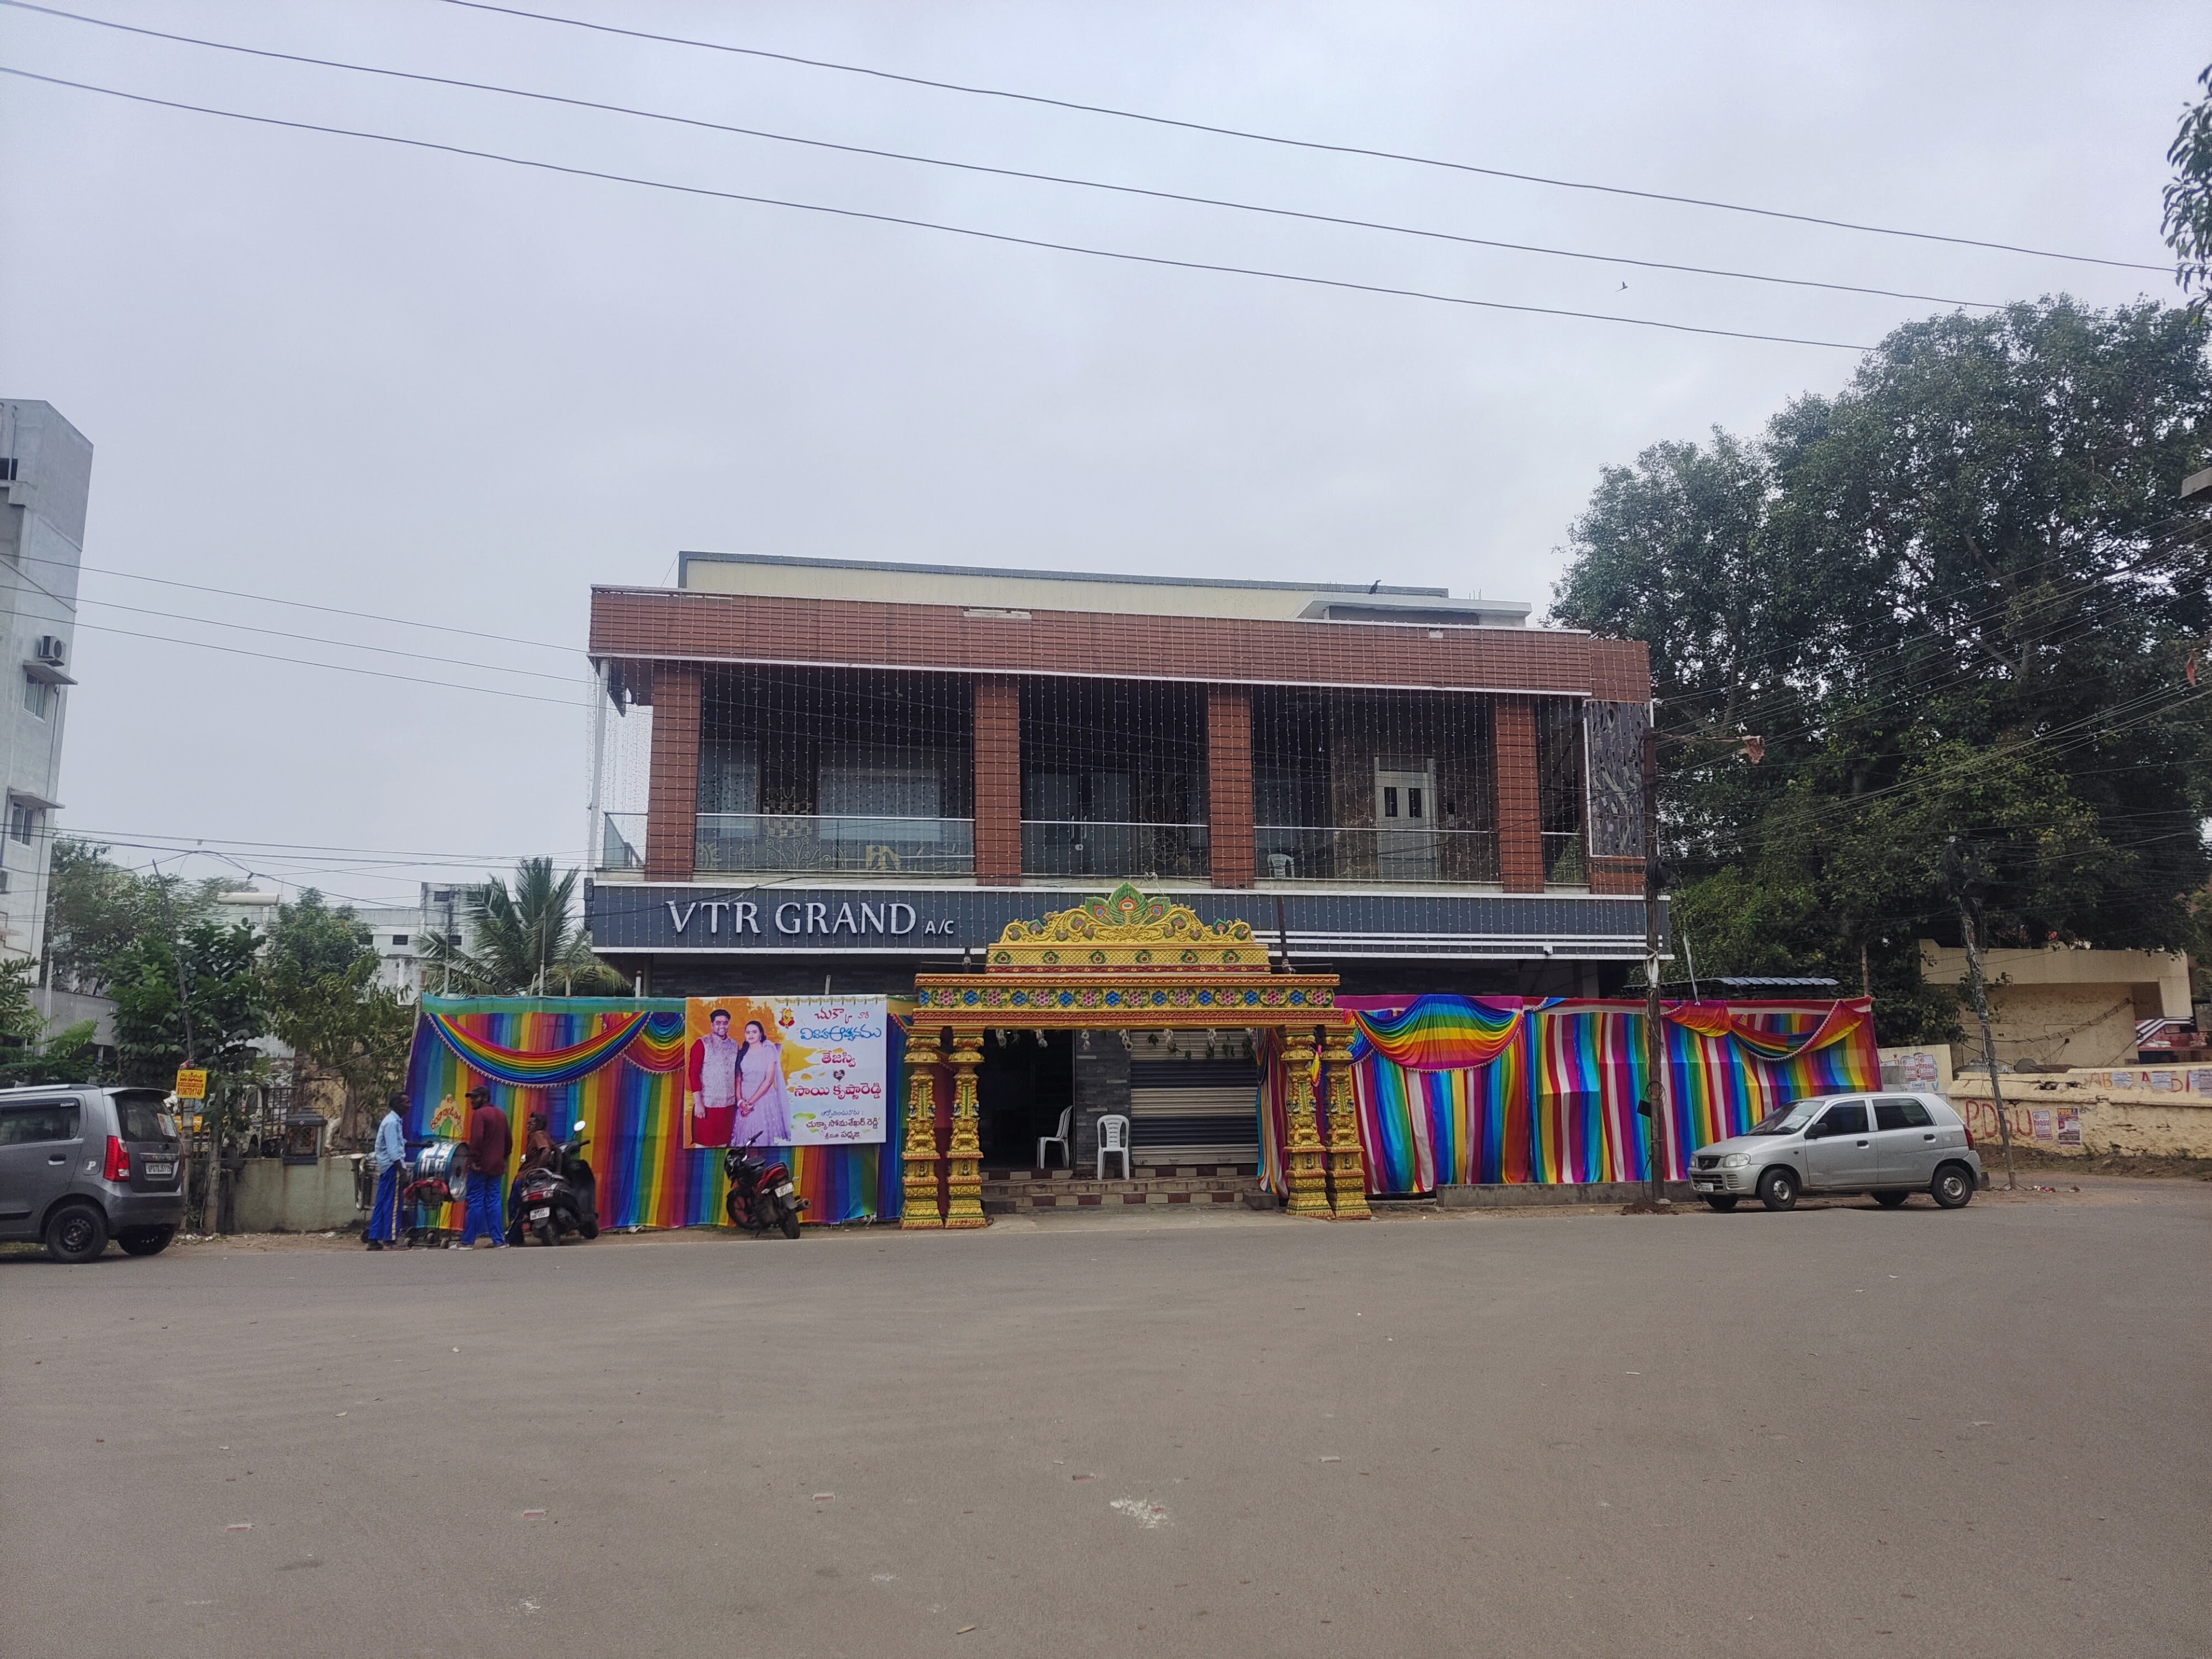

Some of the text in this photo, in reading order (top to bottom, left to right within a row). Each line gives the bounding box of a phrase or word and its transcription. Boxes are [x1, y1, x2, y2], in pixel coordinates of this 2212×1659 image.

[665, 901, 954, 935] VTR GRAND A/C
[821, 1050, 856, 1067] తేజస్వి
[794, 1085, 830, 1097] సాయి
